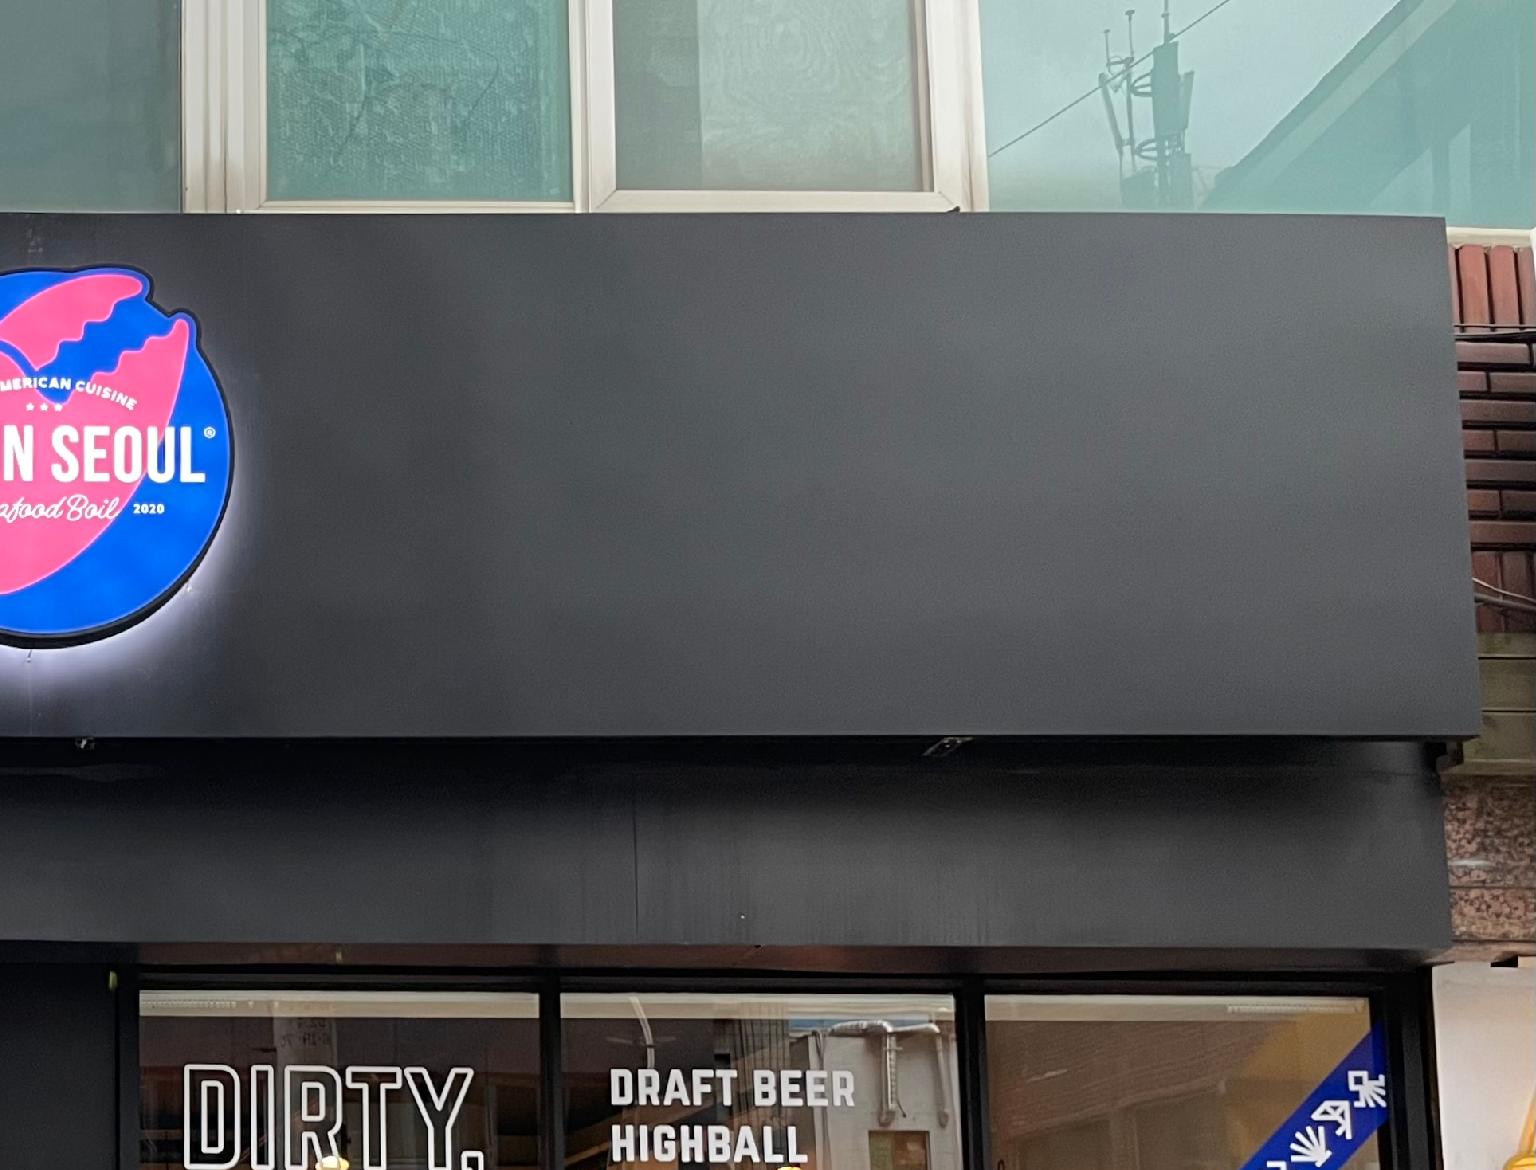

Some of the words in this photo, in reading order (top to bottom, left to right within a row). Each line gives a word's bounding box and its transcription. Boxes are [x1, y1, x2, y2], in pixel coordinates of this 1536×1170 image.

[74, 380, 138, 411] CUISINE
[66, 493, 121, 521] Boil
[132, 502, 165, 515] 2020
[609, 1068, 738, 1107] DRAFT
[752, 1069, 855, 1107] BEER
[611, 1125, 809, 1164] HIGHBALL
